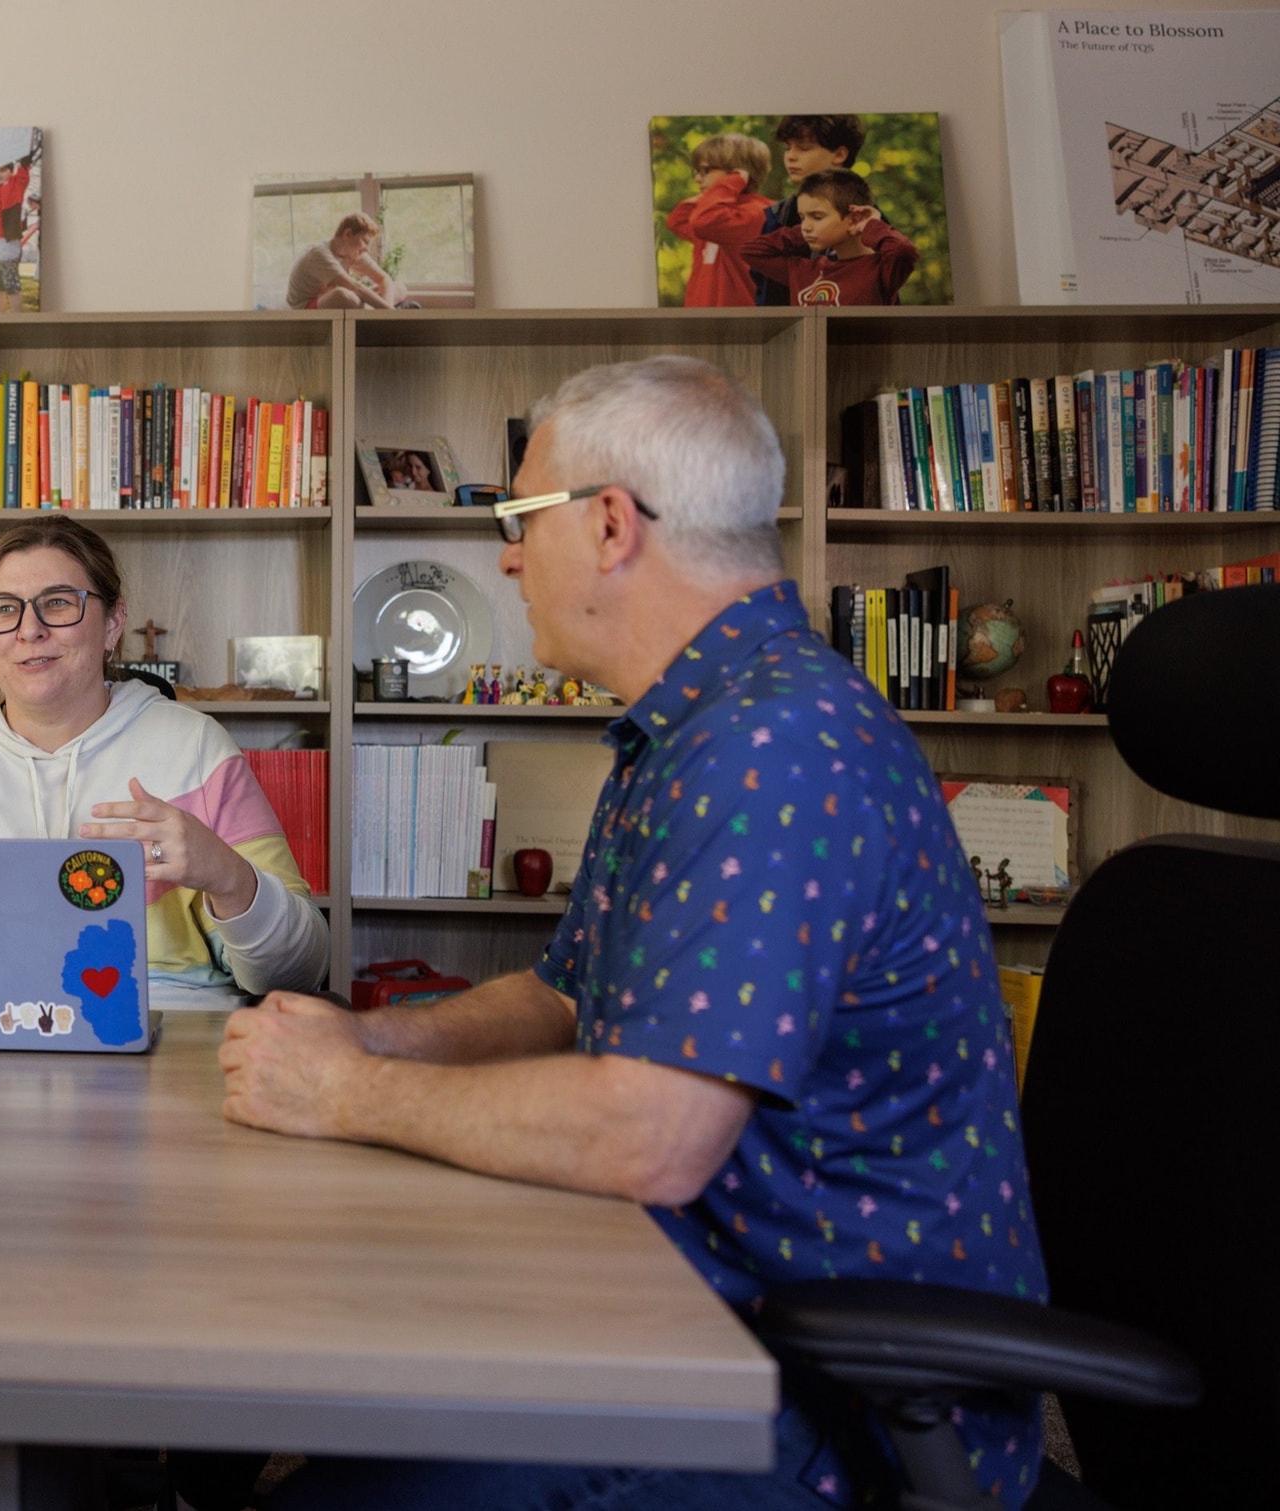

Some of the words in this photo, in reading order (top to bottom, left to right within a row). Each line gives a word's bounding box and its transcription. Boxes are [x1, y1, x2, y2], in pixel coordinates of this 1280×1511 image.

[1058, 21, 1069, 34] A
[1074, 21, 1120, 36] Place
[1126, 24, 1144, 37] to
[1149, 23, 1224, 38] Blossom
[1059, 40, 1079, 50] The
[1082, 41, 1116, 52] Future
[1118, 42, 1129, 52] of
[1131, 43, 1154, 54] TQS
[9, 383, 17, 411] IMPACT
[1062, 387, 1070, 405] OFF
[8, 412, 17, 445] PLAYERS
[225, 417, 233, 432] FANS
[1064, 408, 1072, 425] THE
[224, 434, 232, 451] FIRST
[1020, 430, 1028, 459] Anxious
[1039, 431, 1048, 479] SPECTRUM
[1065, 429, 1074, 477] SPECTRUM
[200, 446, 208, 487] QUESTIONS
[1125, 447, 1135, 477] TEENS
[1022, 459, 1030, 500] Generation
[65, 851, 111, 873] CALIFORNIA
